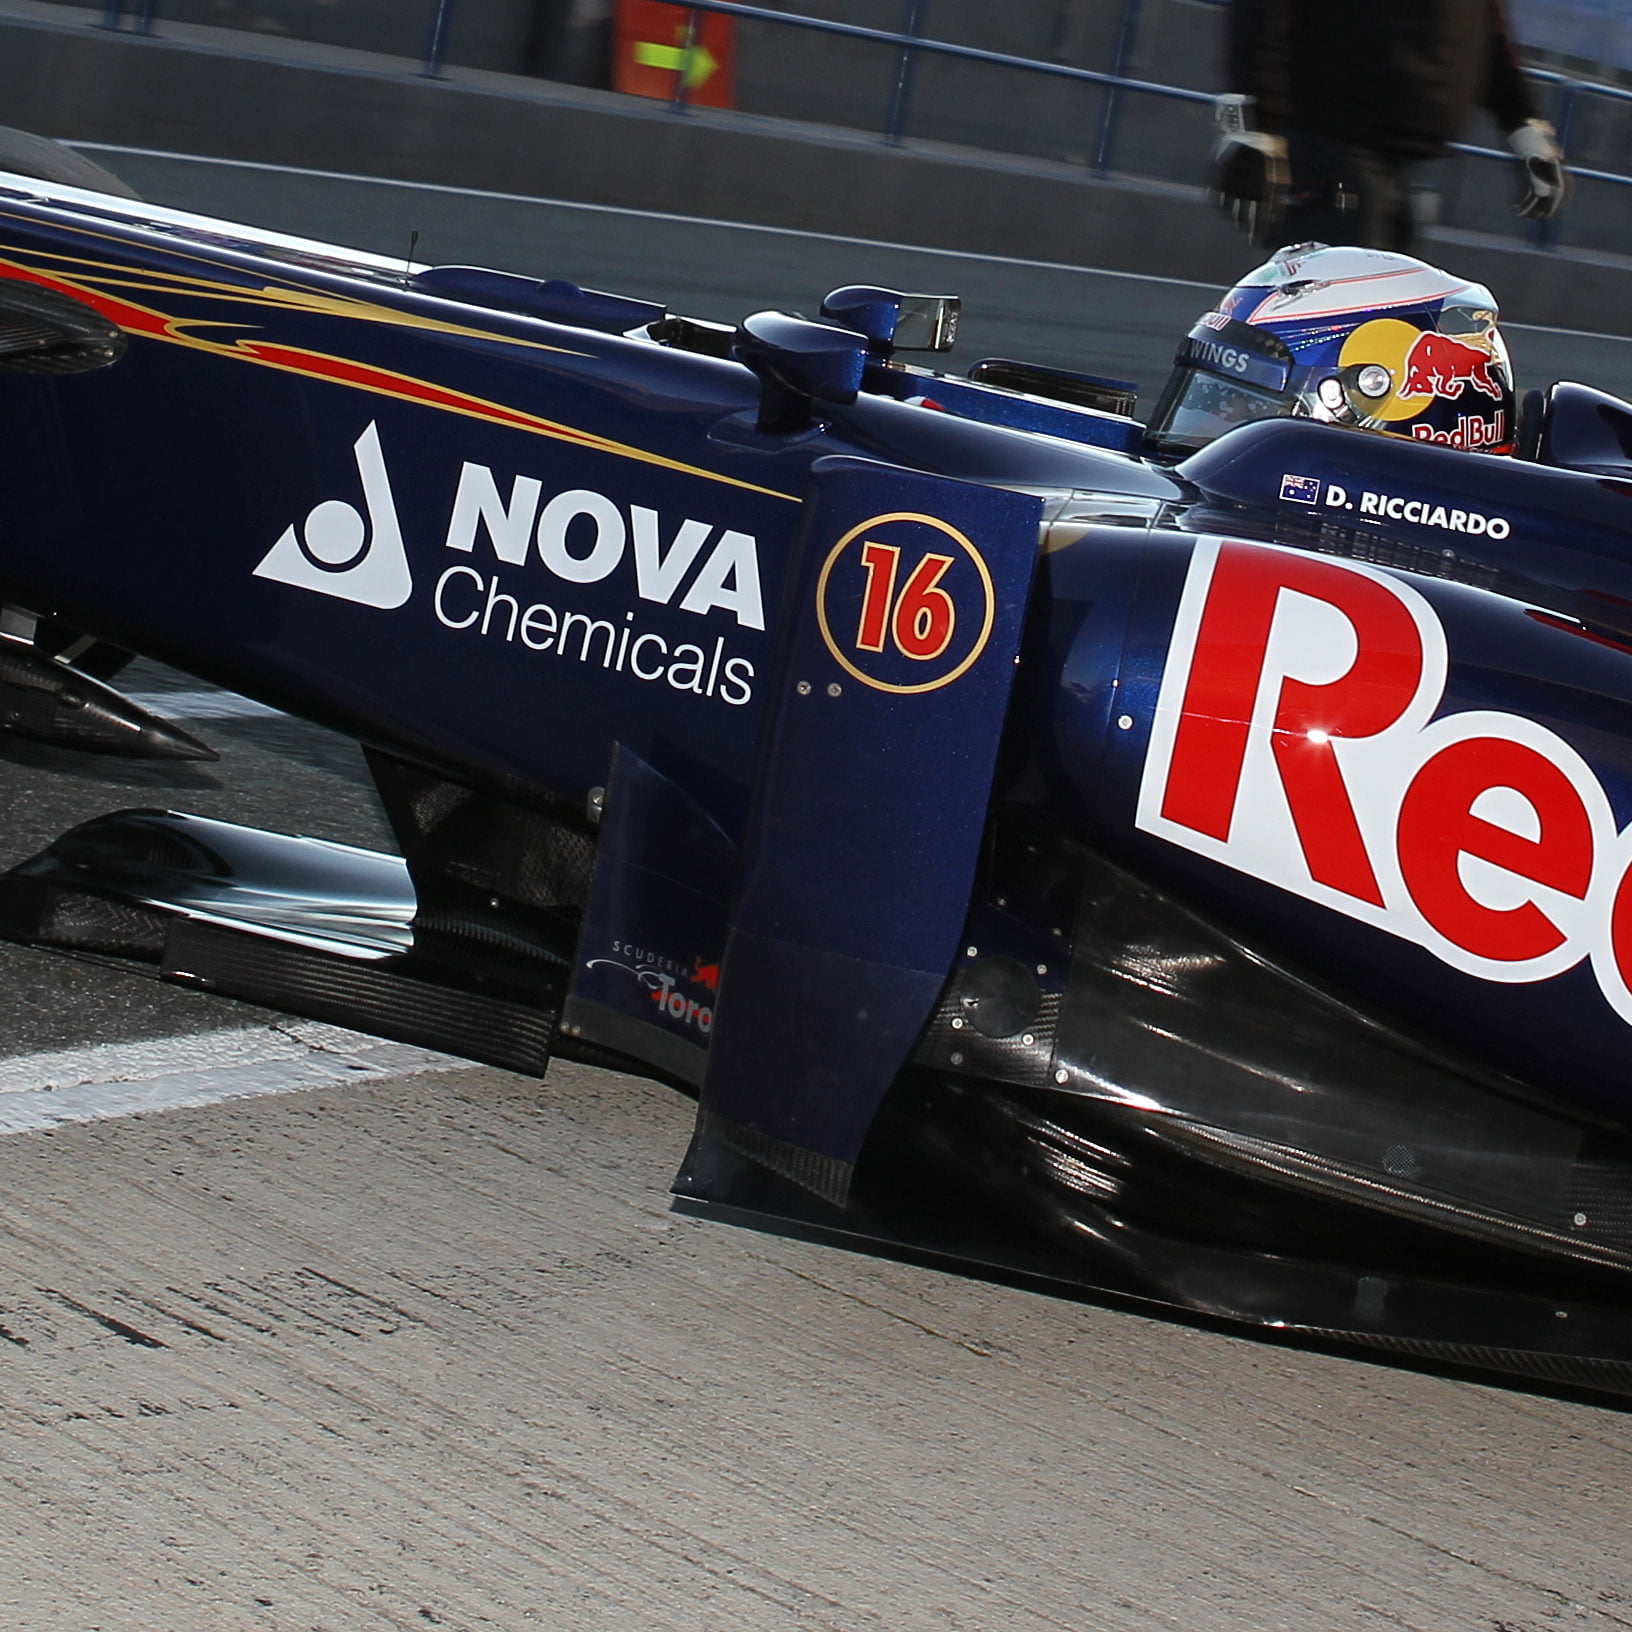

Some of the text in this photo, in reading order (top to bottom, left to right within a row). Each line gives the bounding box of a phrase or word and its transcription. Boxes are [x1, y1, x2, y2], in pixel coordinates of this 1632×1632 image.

[1190, 338, 1250, 373] WINGS
[1468, 409, 1504, 448] Bull
[1325, 484, 1511, 540] D. RICCIARDO
[446, 461, 766, 631] NOVA
[855, 540, 956, 661] 16
[434, 565, 754, 706] Chemicals
[612, 940, 689, 979] SCUDERIA
[656, 972, 713, 1033] Toro
